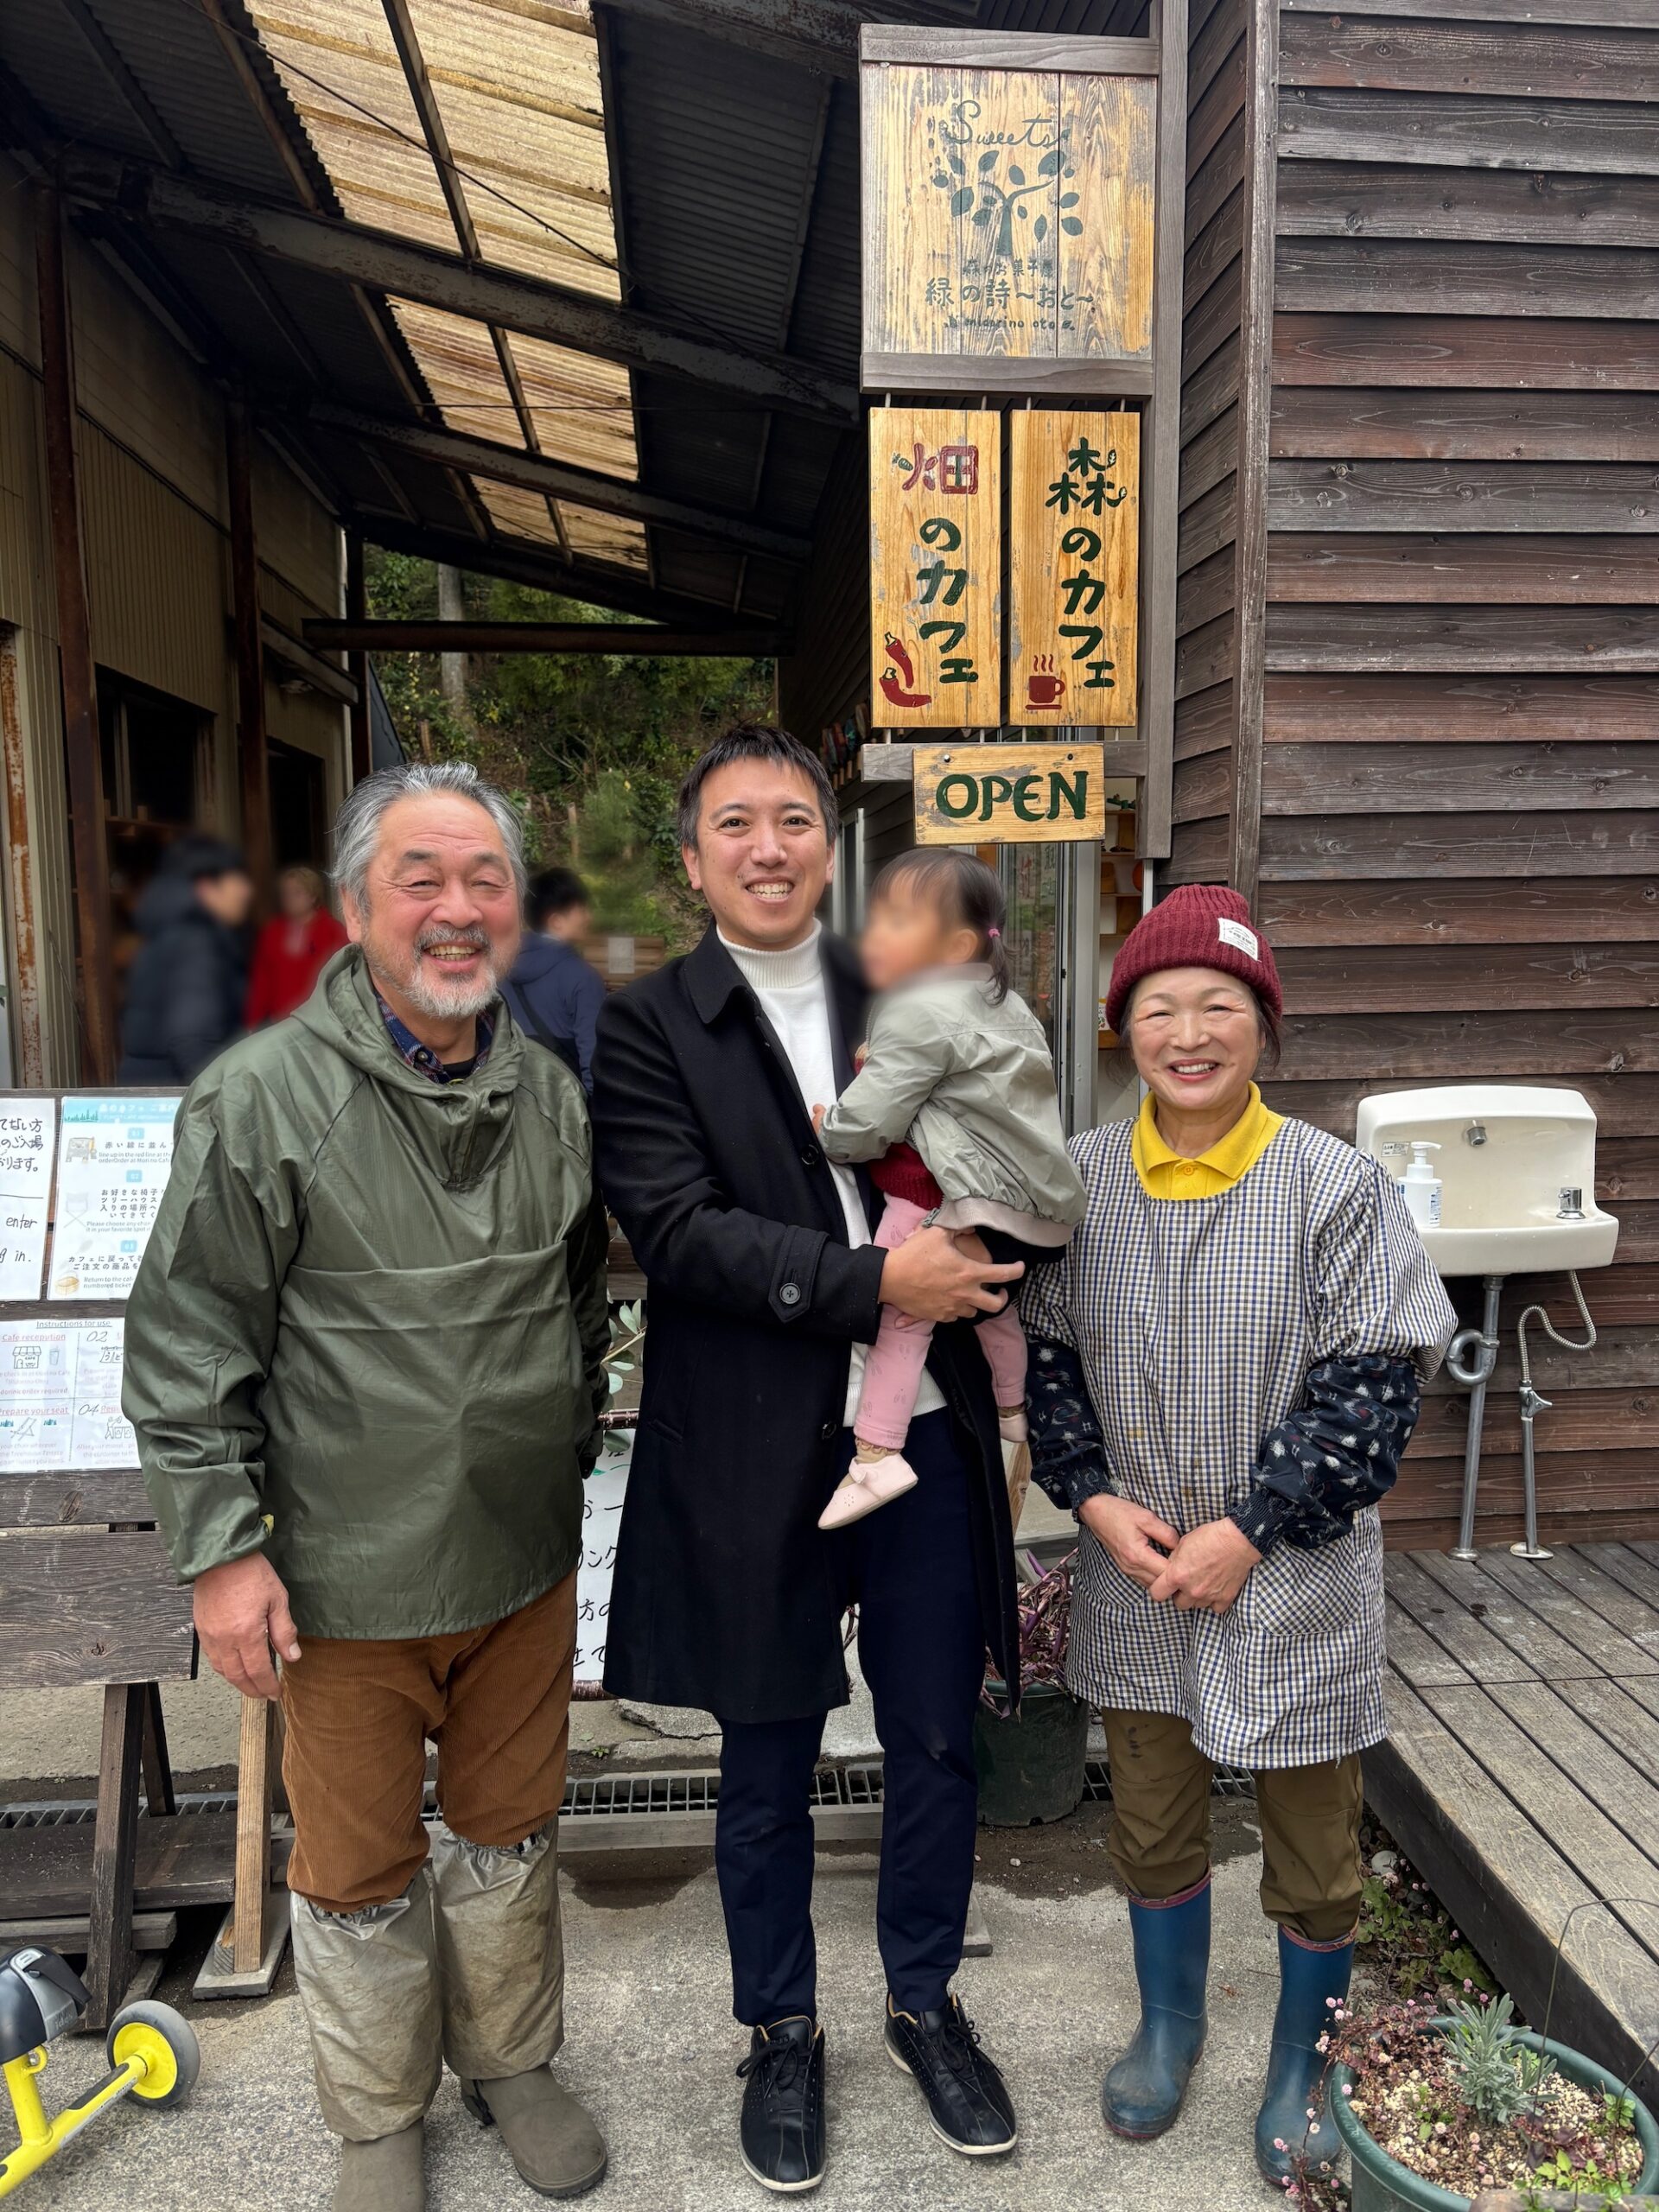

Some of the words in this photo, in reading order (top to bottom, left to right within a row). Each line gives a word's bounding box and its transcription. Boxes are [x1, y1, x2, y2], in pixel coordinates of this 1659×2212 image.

[947, 100, 1063, 148] Sweets
[965, 316, 1024, 328] midorino
[1033, 319, 1055, 329] oto
[892, 442, 979, 683] 畑のカフェ
[1046, 436, 1127, 688] 森のカフェ
[936, 771, 1089, 822] OPEN
[6, 1213, 37, 1229] enter
[87, 1331, 108, 1342] 02
